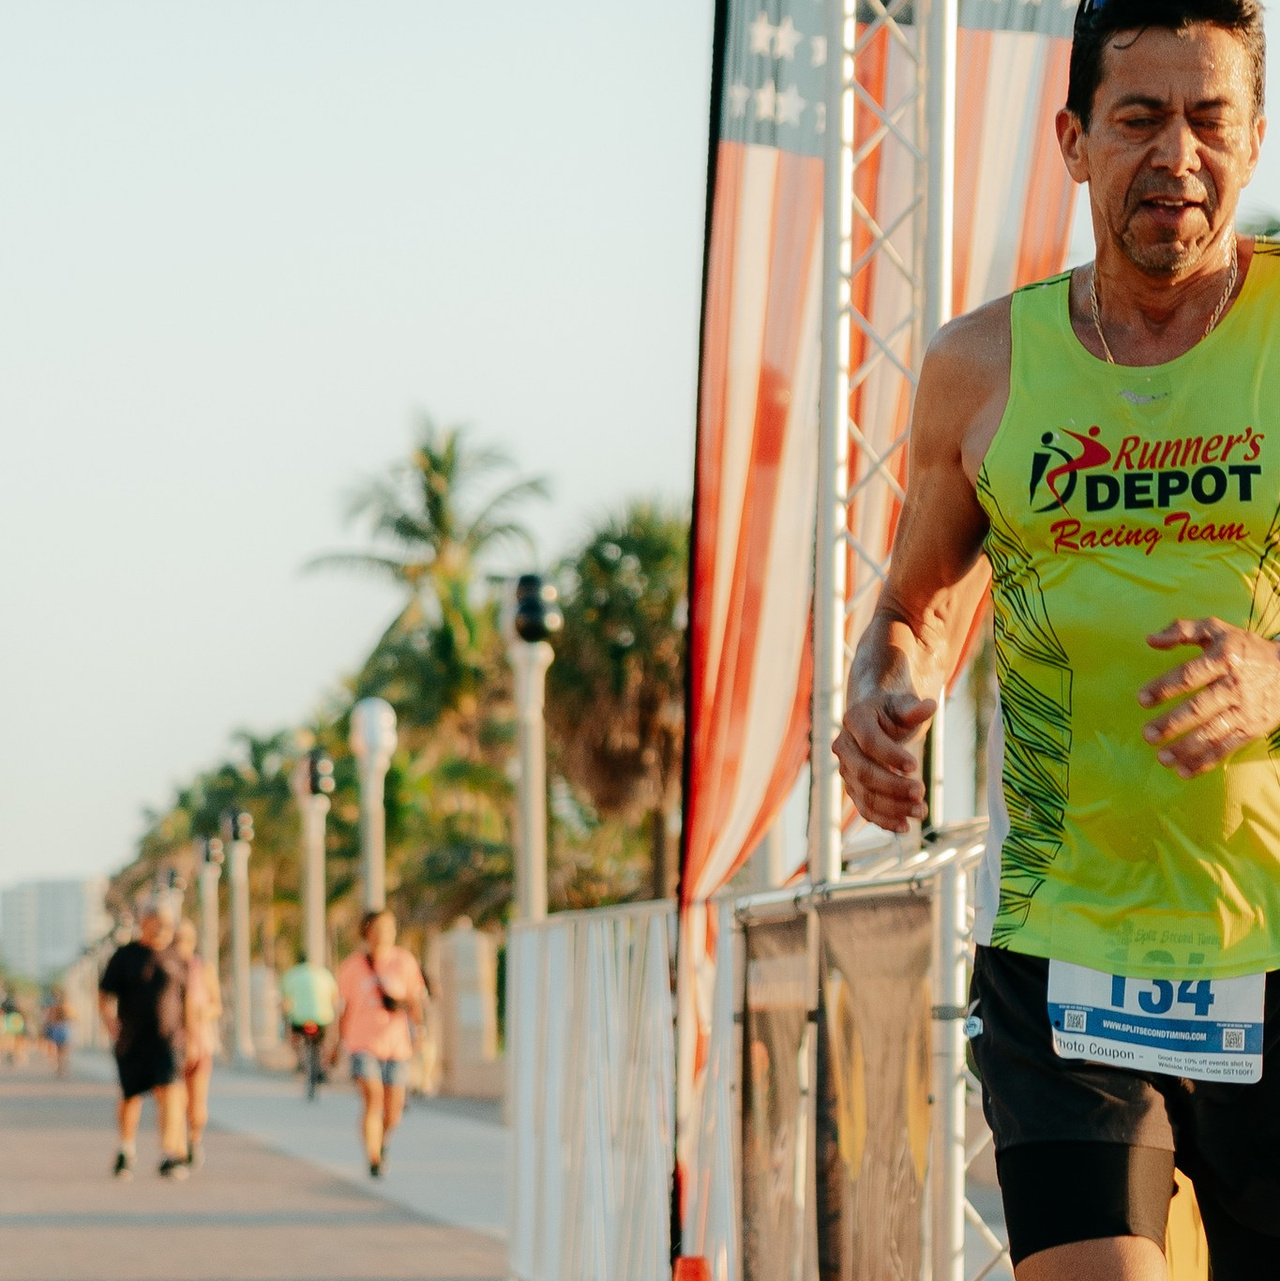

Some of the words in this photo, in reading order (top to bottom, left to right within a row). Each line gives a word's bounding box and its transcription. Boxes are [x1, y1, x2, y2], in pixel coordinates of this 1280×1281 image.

[1112, 426, 1265, 472] Runner's
[1085, 465, 1262, 512] DEPOT
[1050, 518, 1162, 556] Racing
[1164, 511, 1249, 543] Team
[1089, 1042, 1135, 1060] Coupon
[1102, 1020, 1207, 1042] WWW.SPLITSECONDTIMING.COM
